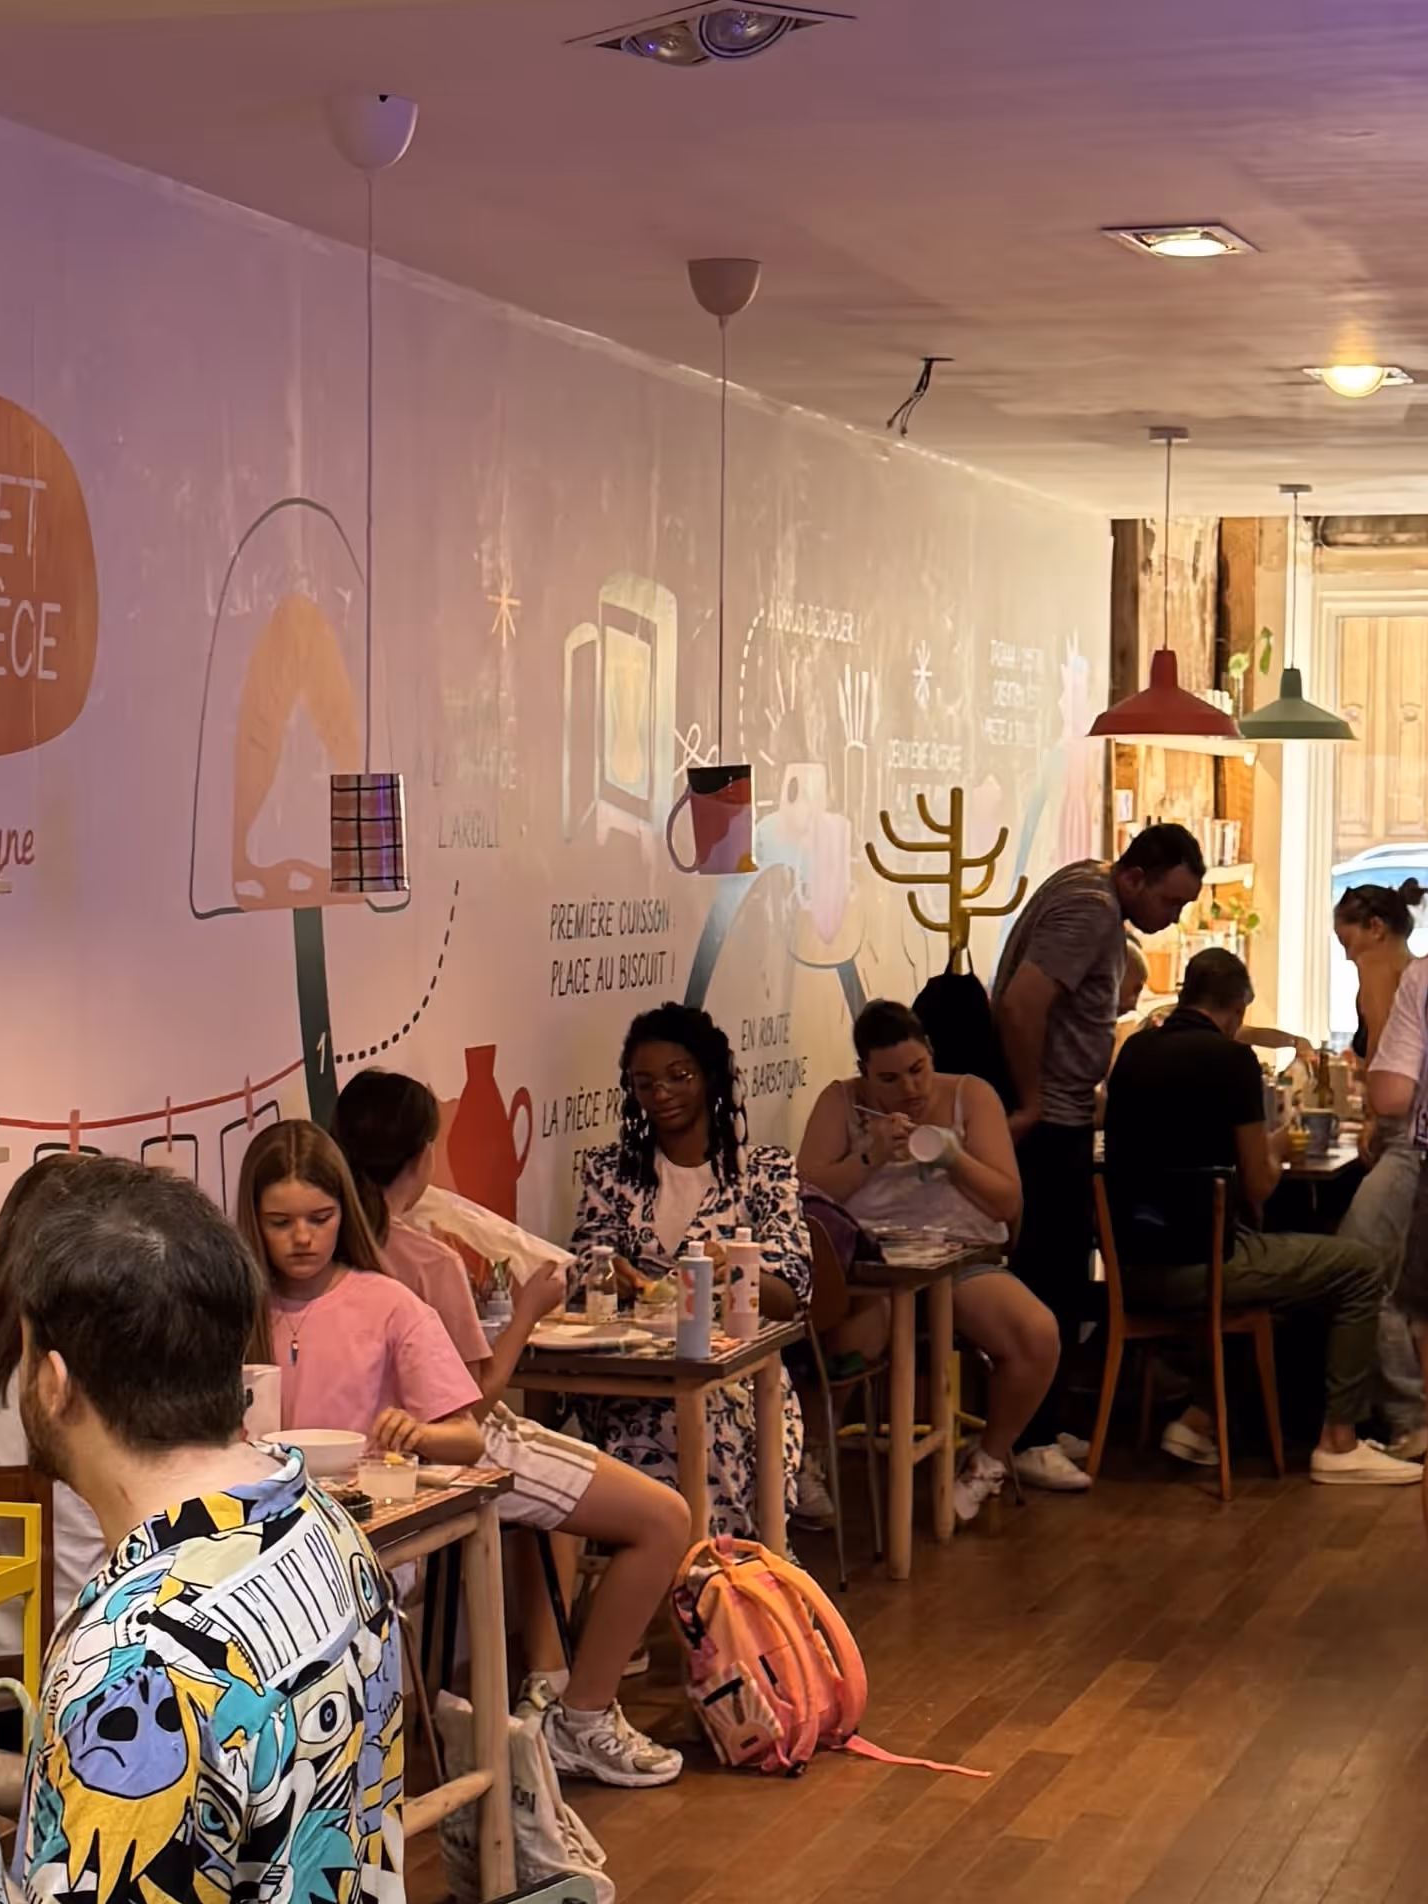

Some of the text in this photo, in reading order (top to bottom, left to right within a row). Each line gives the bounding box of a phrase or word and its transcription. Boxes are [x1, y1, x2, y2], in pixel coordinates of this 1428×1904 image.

[550, 893, 614, 941] PREMIÈRE
[619, 899, 670, 935] CUISSON
[551, 957, 591, 997] PLACE
[595, 956, 614, 992] AU
[619, 950, 667, 990] BISCUIT
[316, 1031, 326, 1074] 1
[741, 1012, 791, 1051] EN ROUTE
[542, 1099, 558, 1138] LA
[565, 1086, 601, 1133] PIÈCE
[211, 1523, 351, 1682] LET IT GO
